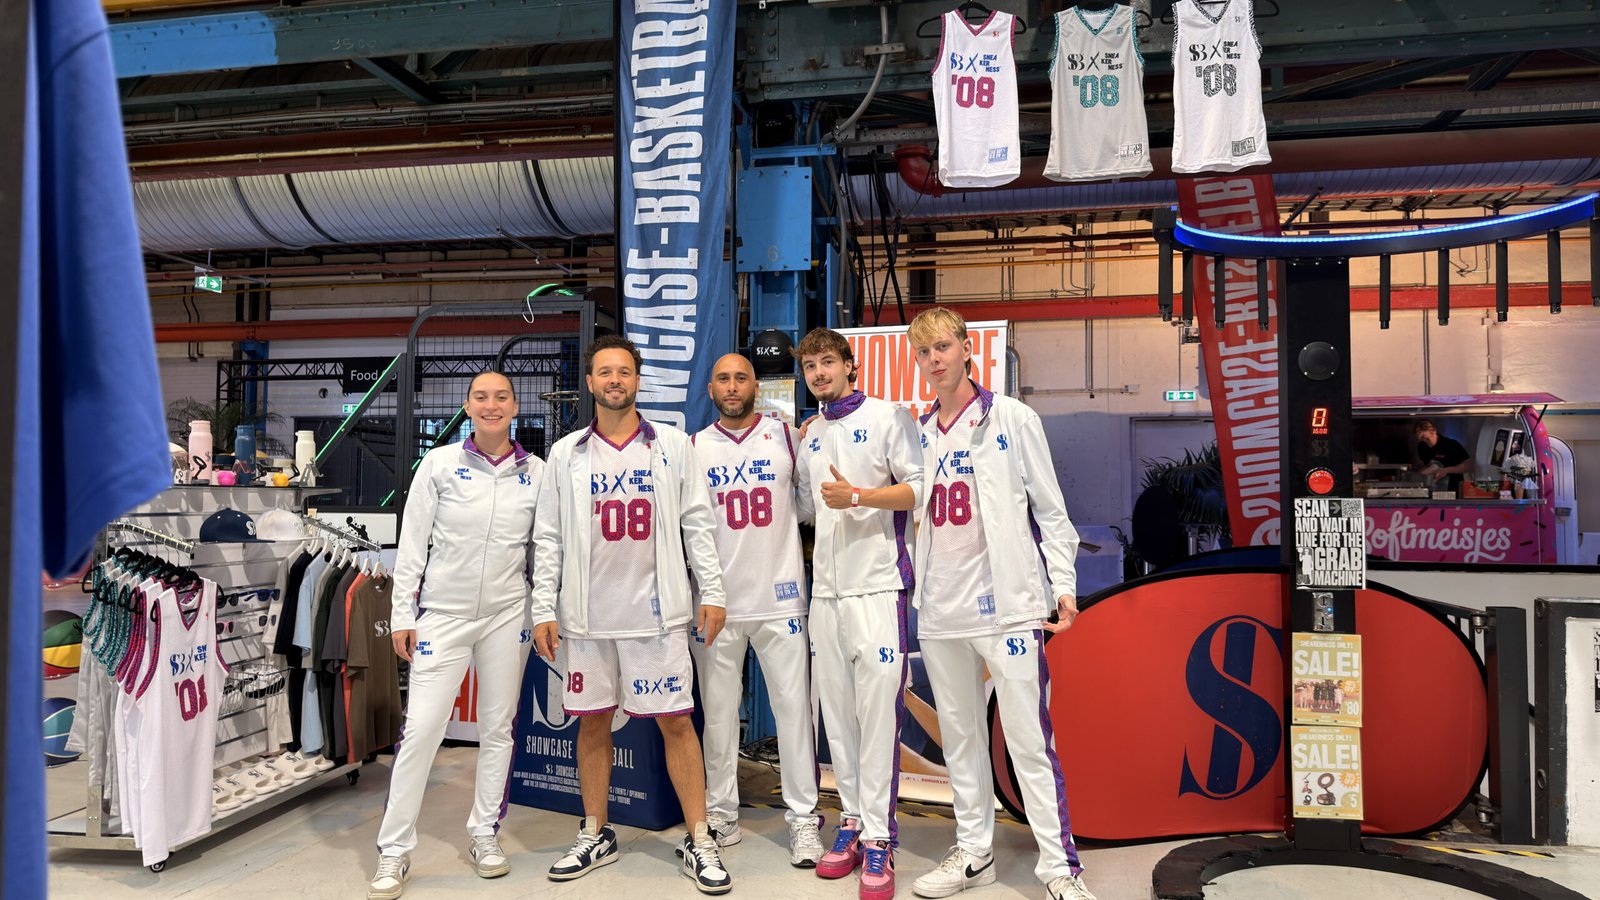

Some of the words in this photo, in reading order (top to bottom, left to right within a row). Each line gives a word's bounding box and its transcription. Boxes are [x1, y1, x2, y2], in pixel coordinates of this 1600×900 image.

[350, 370, 378, 380] Food
[1312, 408, 1327, 427] 0
[953, 450, 970, 458] SNEA
[950, 459, 961, 467] KER
[633, 469, 652, 477] SNEA
[758, 473, 776, 481] NESS
[629, 477, 643, 485] KER
[717, 486, 772, 530] '08
[1294, 499, 1330, 517] SCAN
[1295, 517, 1318, 532] AND
[1320, 517, 1348, 532] WAIT
[1350, 517, 1362, 532] IN
[1296, 532, 1318, 547] LINE
[1319, 533, 1341, 547] FOR
[1342, 533, 1362, 548] THE
[1314, 547, 1362, 571] GRAB
[1314, 571, 1362, 586] MACHINE
[1337, 641, 1353, 649] ONLY!
[1294, 649, 1360, 678] SALE!
[526, 735, 573, 759] SHOWCASE
[1293, 742, 1359, 770] SALE!
